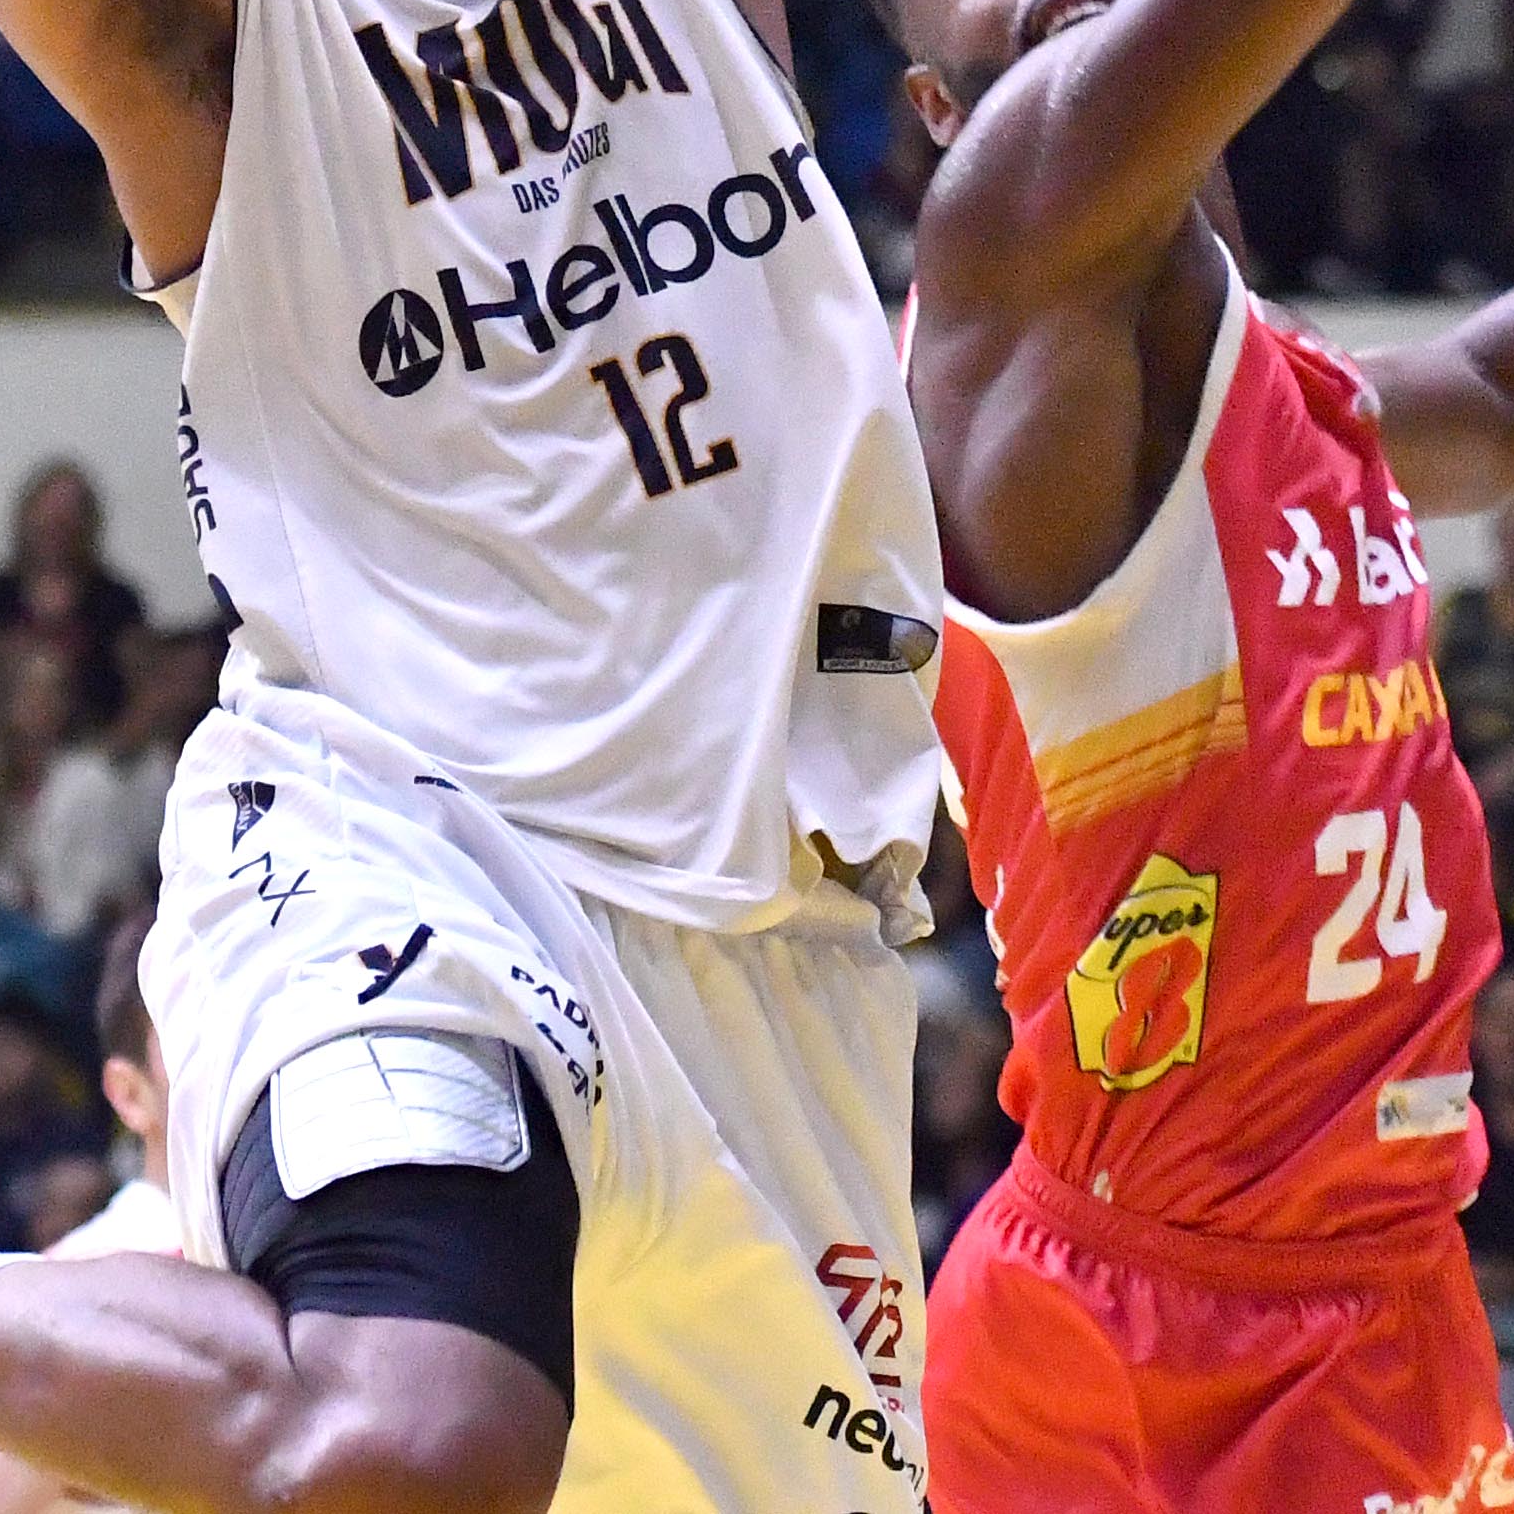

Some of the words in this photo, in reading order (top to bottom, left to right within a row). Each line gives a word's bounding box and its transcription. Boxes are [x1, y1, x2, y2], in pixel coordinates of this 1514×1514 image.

[437, 141, 817, 373] Helbor
[511, 176, 560, 215] DAS
[589, 332, 740, 500] 12
[1306, 800, 1448, 1005] 24
